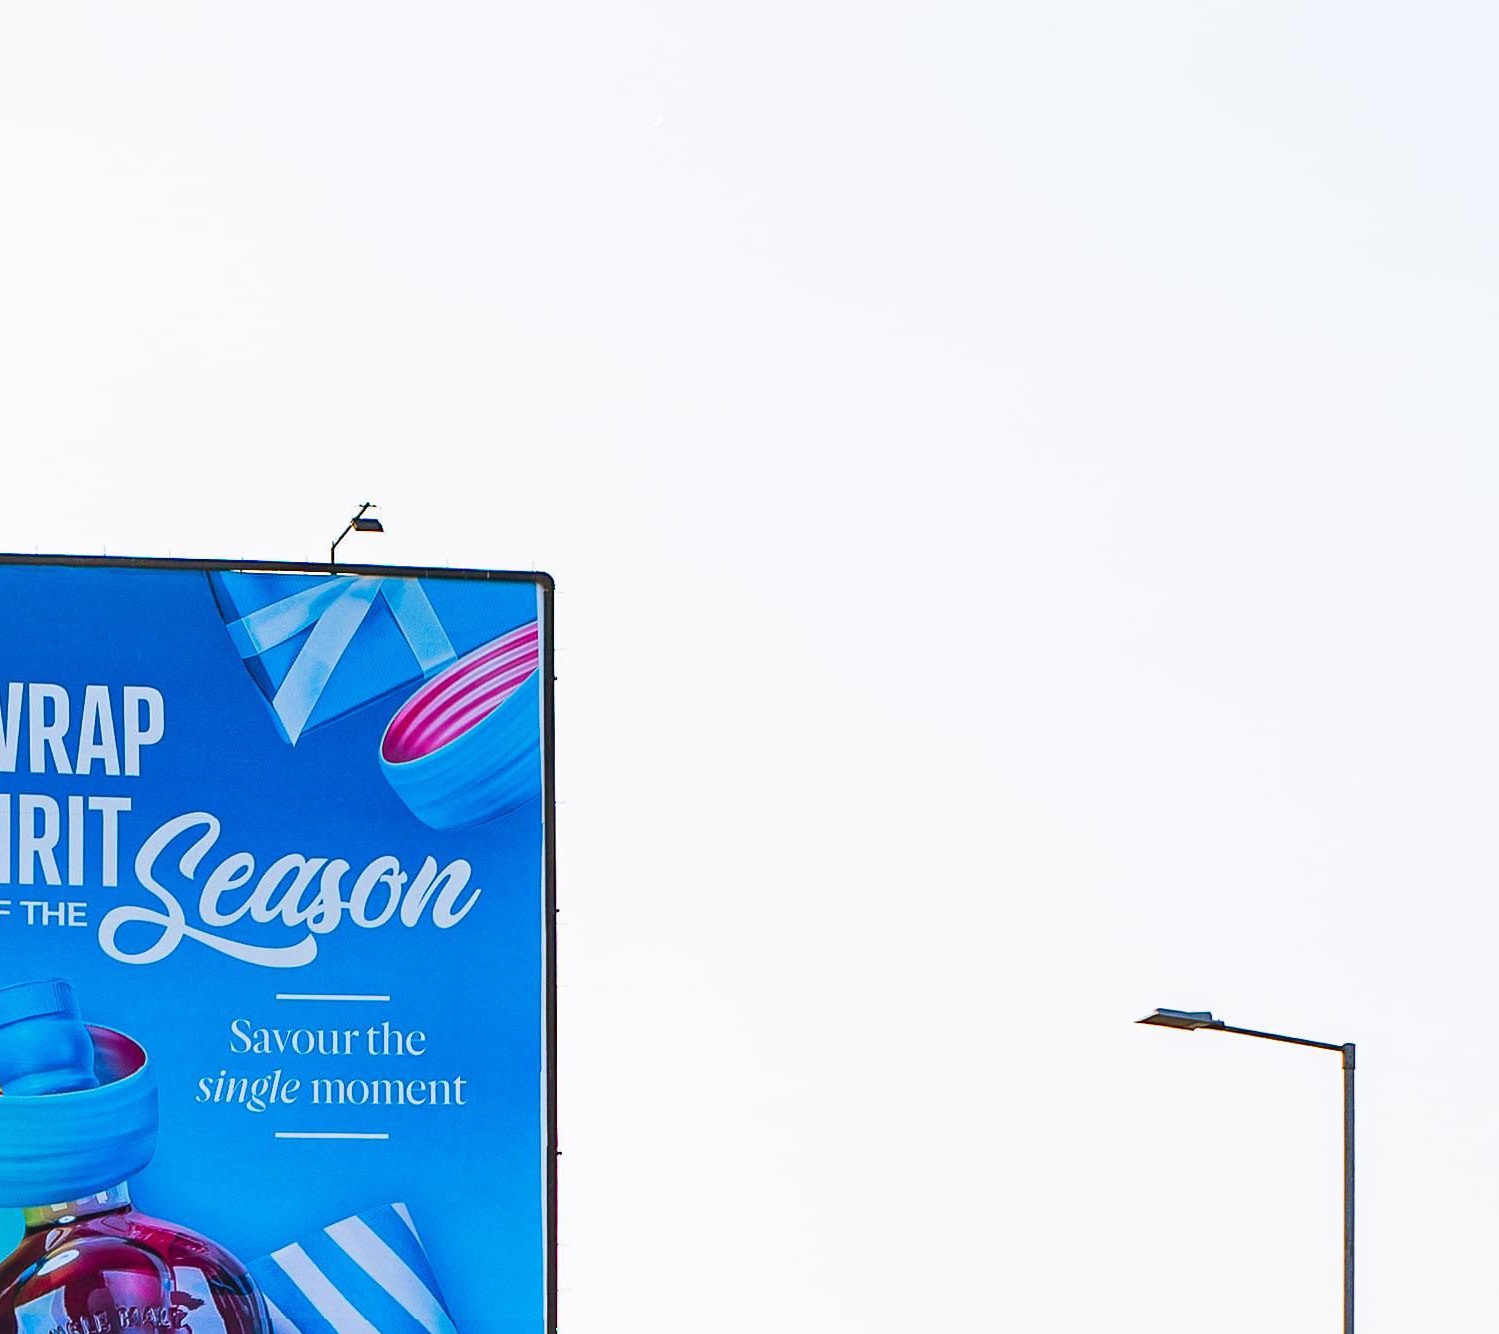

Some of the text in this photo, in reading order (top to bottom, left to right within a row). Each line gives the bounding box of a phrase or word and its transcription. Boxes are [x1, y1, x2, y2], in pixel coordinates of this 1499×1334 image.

[19, 901, 88, 927] THE
[98, 811, 481, 968] Season
[230, 1018, 426, 1055] Savour the
[196, 1069, 467, 1112] single moment
